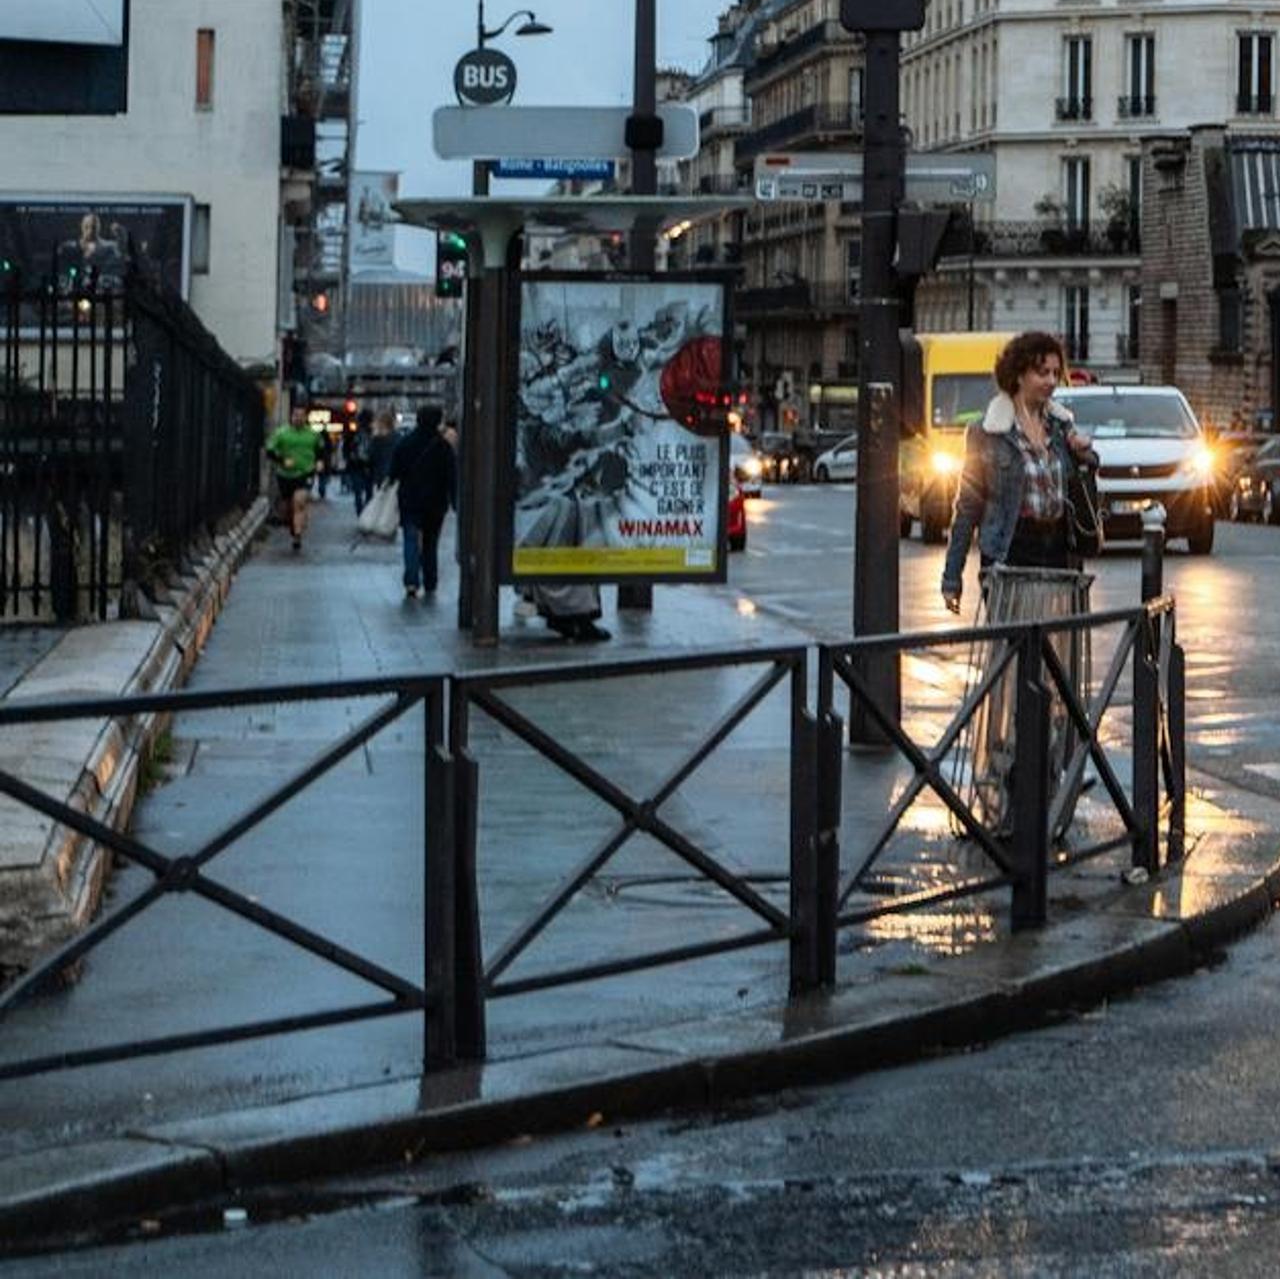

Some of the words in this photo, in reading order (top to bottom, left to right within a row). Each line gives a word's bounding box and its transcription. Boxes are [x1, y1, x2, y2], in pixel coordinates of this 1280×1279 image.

[463, 65, 508, 87] BUS
[657, 444, 670, 460] LE
[676, 444, 706, 460] PLUS
[640, 463, 707, 479] IMPORTANT
[649, 481, 685, 497] C'EST
[690, 481, 703, 496] DE
[657, 498, 704, 515] GAGNER
[618, 519, 704, 537] WINAMAX
